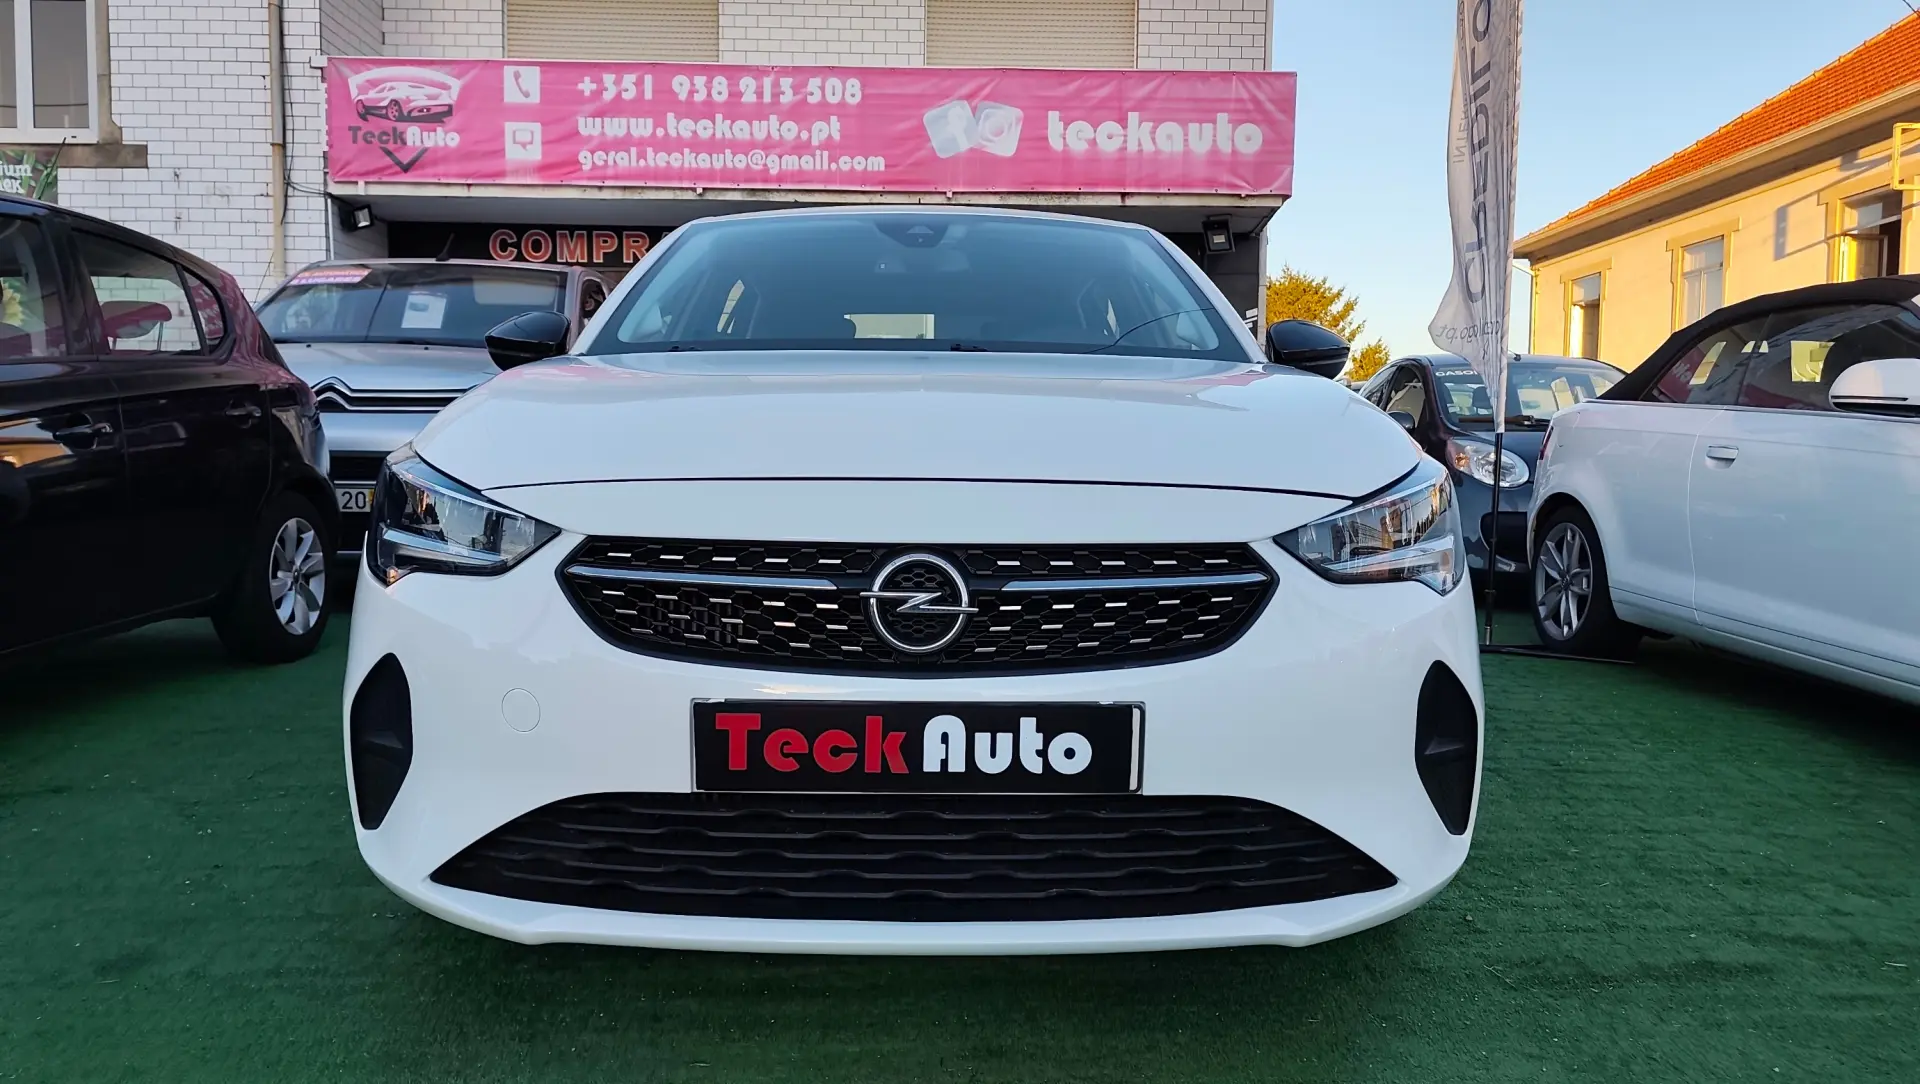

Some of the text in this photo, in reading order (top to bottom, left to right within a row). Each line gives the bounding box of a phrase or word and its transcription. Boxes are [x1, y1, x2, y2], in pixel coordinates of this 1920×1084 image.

[577, 74, 862, 105] +351 938 213 508
[577, 112, 841, 146] www.teckauto.pt
[1047, 110, 1264, 155] teckauto
[577, 146, 886, 175] geral.teckauto@gmail.com
[341, 490, 367, 510] 20
